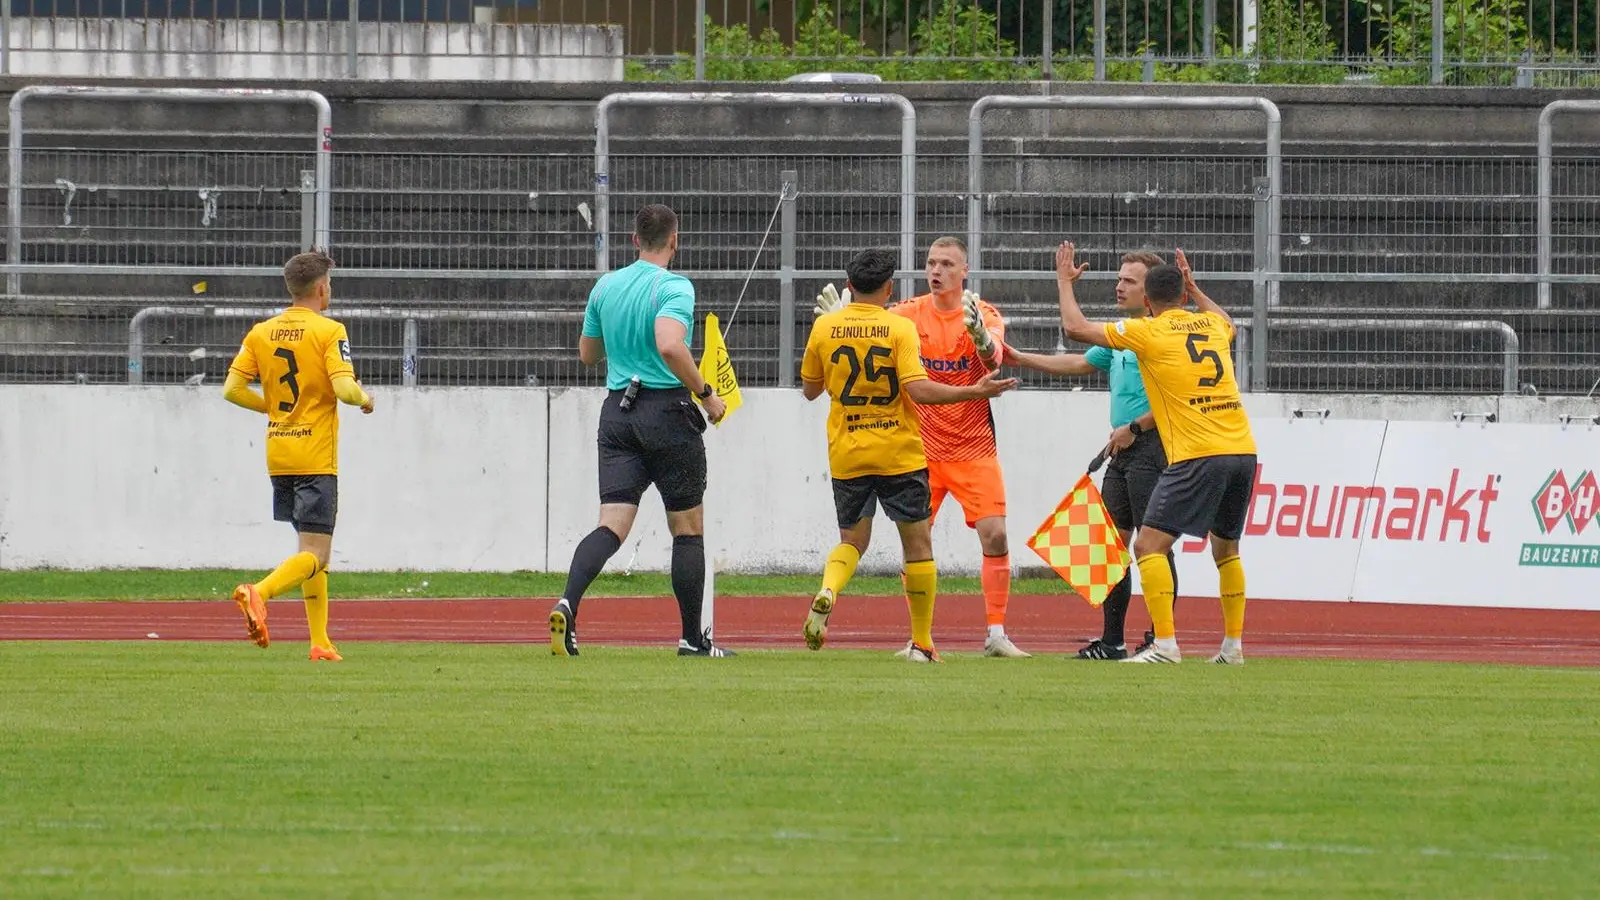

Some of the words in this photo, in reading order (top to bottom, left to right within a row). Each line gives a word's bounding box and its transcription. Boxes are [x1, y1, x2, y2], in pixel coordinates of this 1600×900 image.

[270, 328, 305, 342] LIPPERT
[830, 325, 890, 339] ZEJNULLAHU
[1185, 333, 1224, 387] 5
[273, 347, 300, 413] 3
[830, 344, 900, 407] 25
[268, 428, 313, 439] greenlight
[847, 419, 900, 433] greenlight
[1182, 463, 1498, 553] baumarkt
[1522, 547, 1599, 564] BAUZENTR
